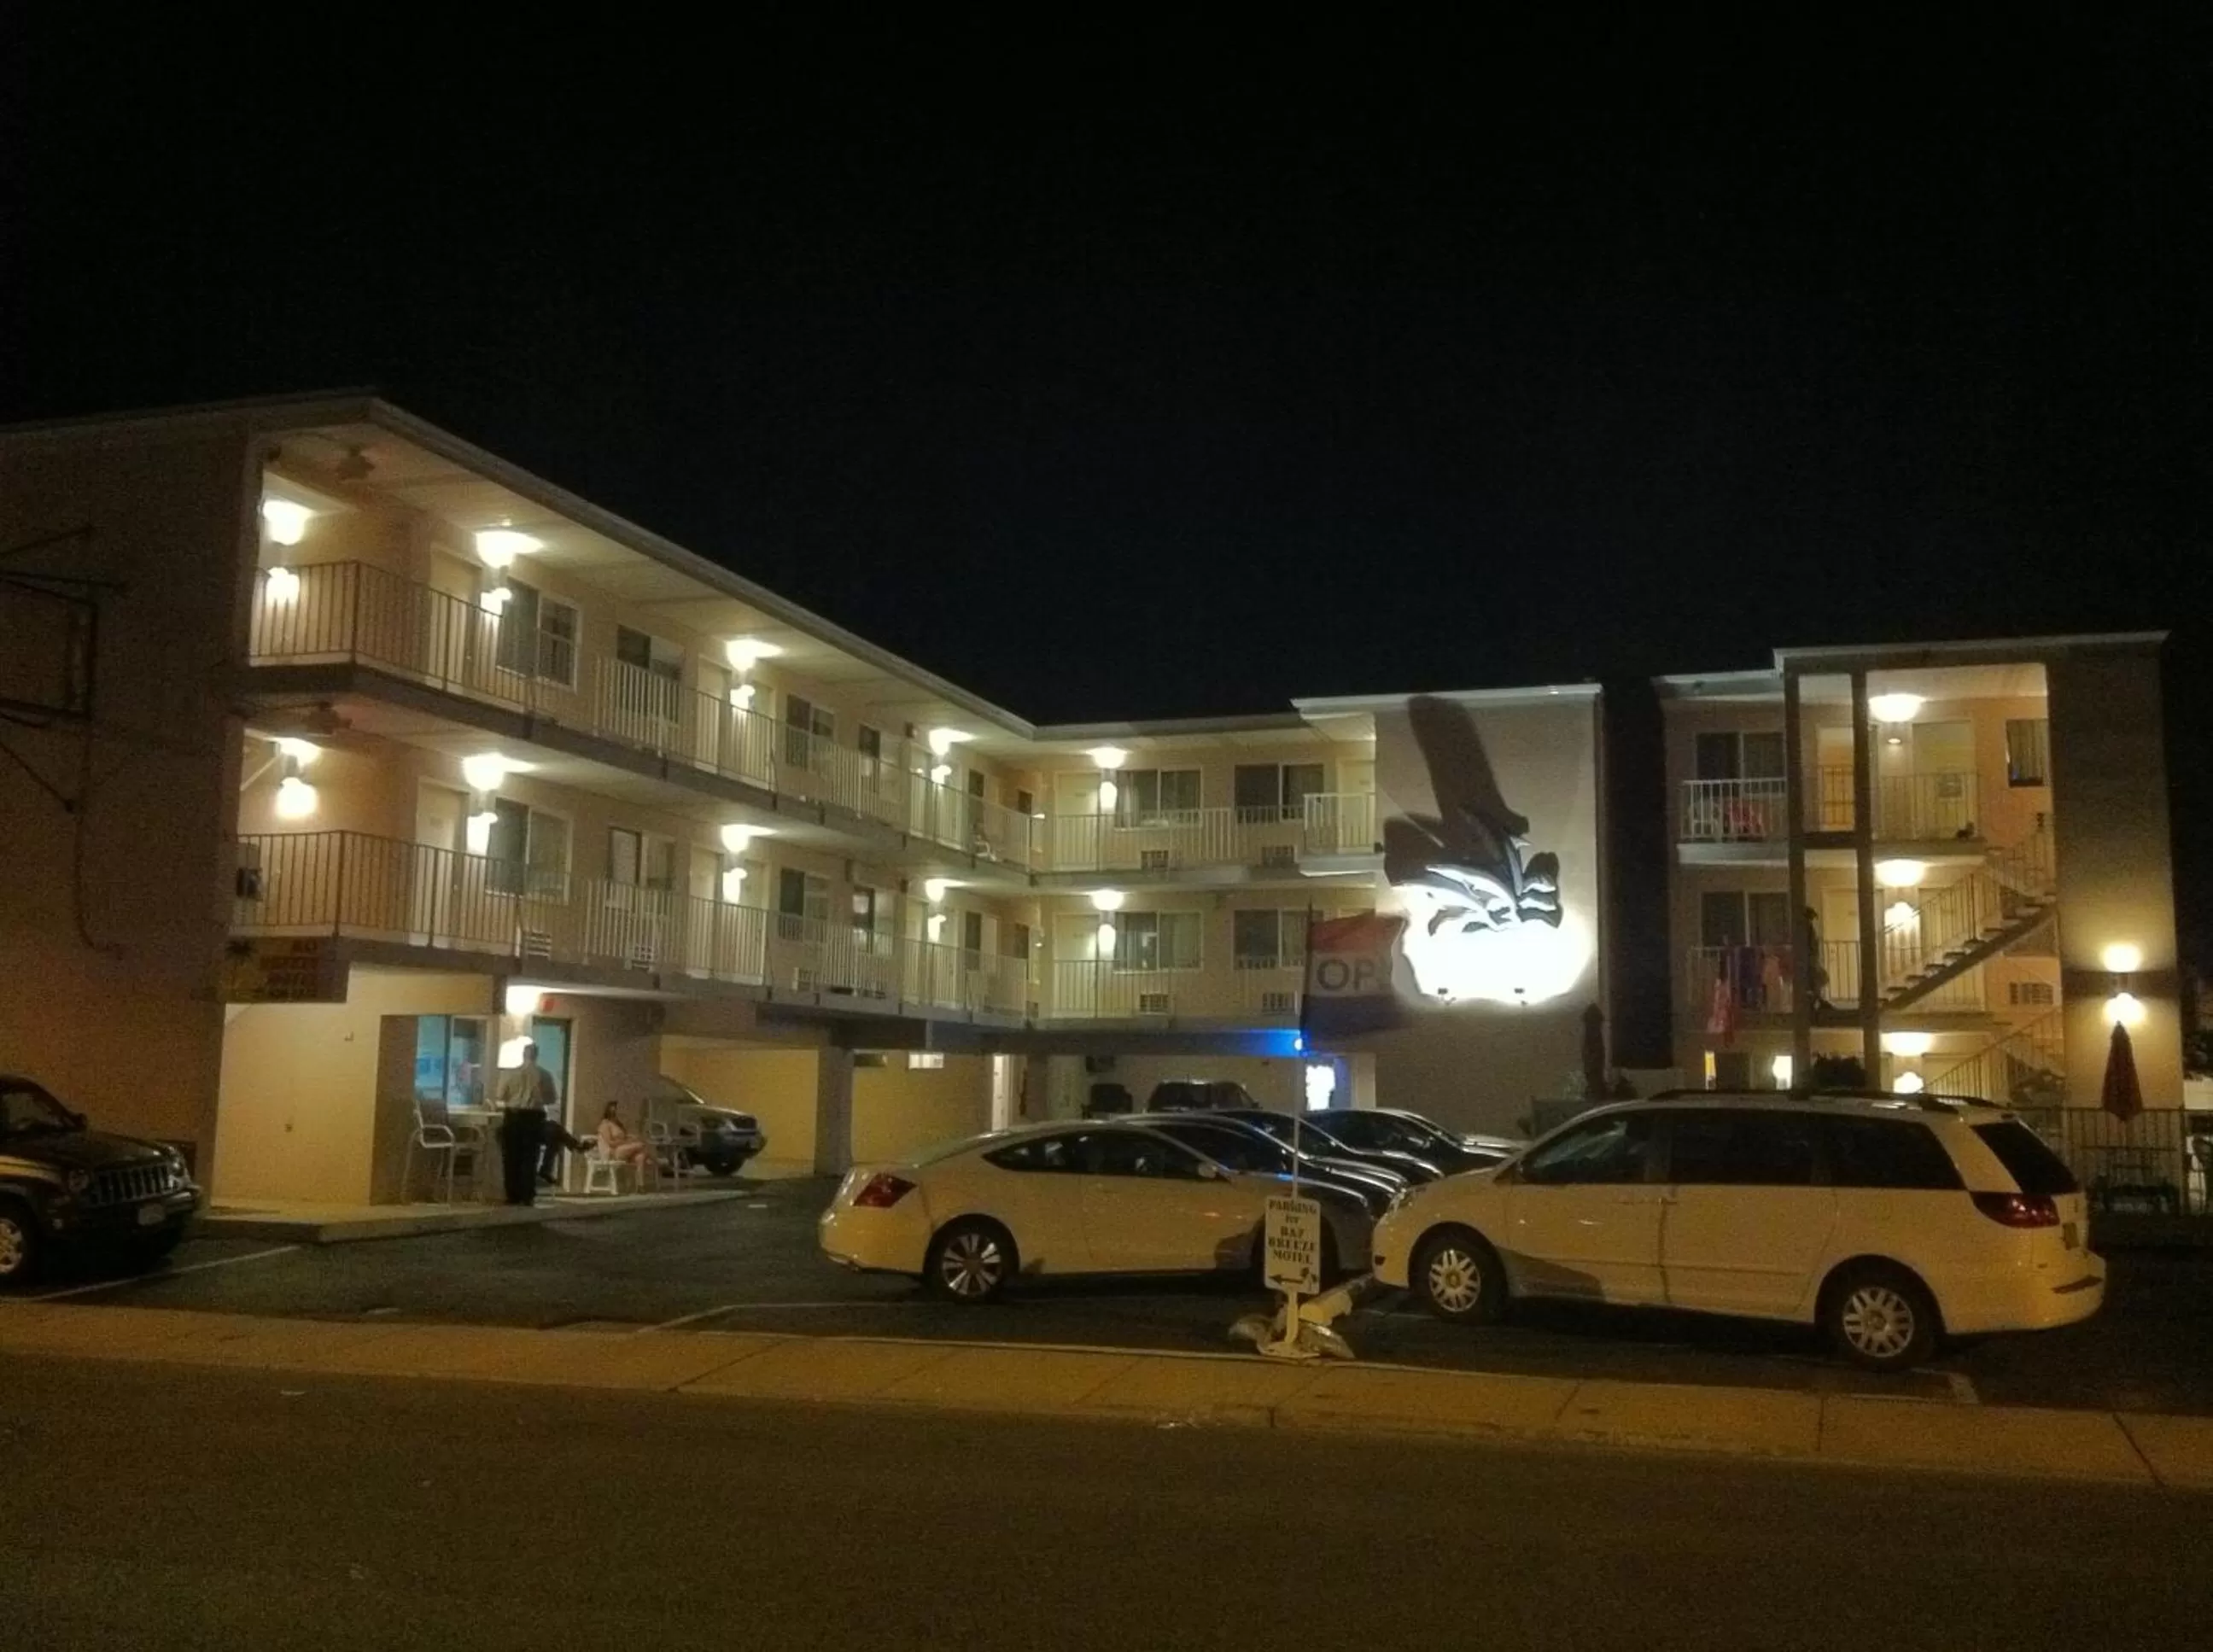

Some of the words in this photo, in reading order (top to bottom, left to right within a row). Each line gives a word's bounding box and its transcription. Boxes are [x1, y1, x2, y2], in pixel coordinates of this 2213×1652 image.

[1317, 957, 1375, 991] OP
[1269, 1199, 1317, 1214] PARKING
[1280, 1225, 1305, 1238] BAY
[1272, 1249, 1313, 1264] MOTEL
